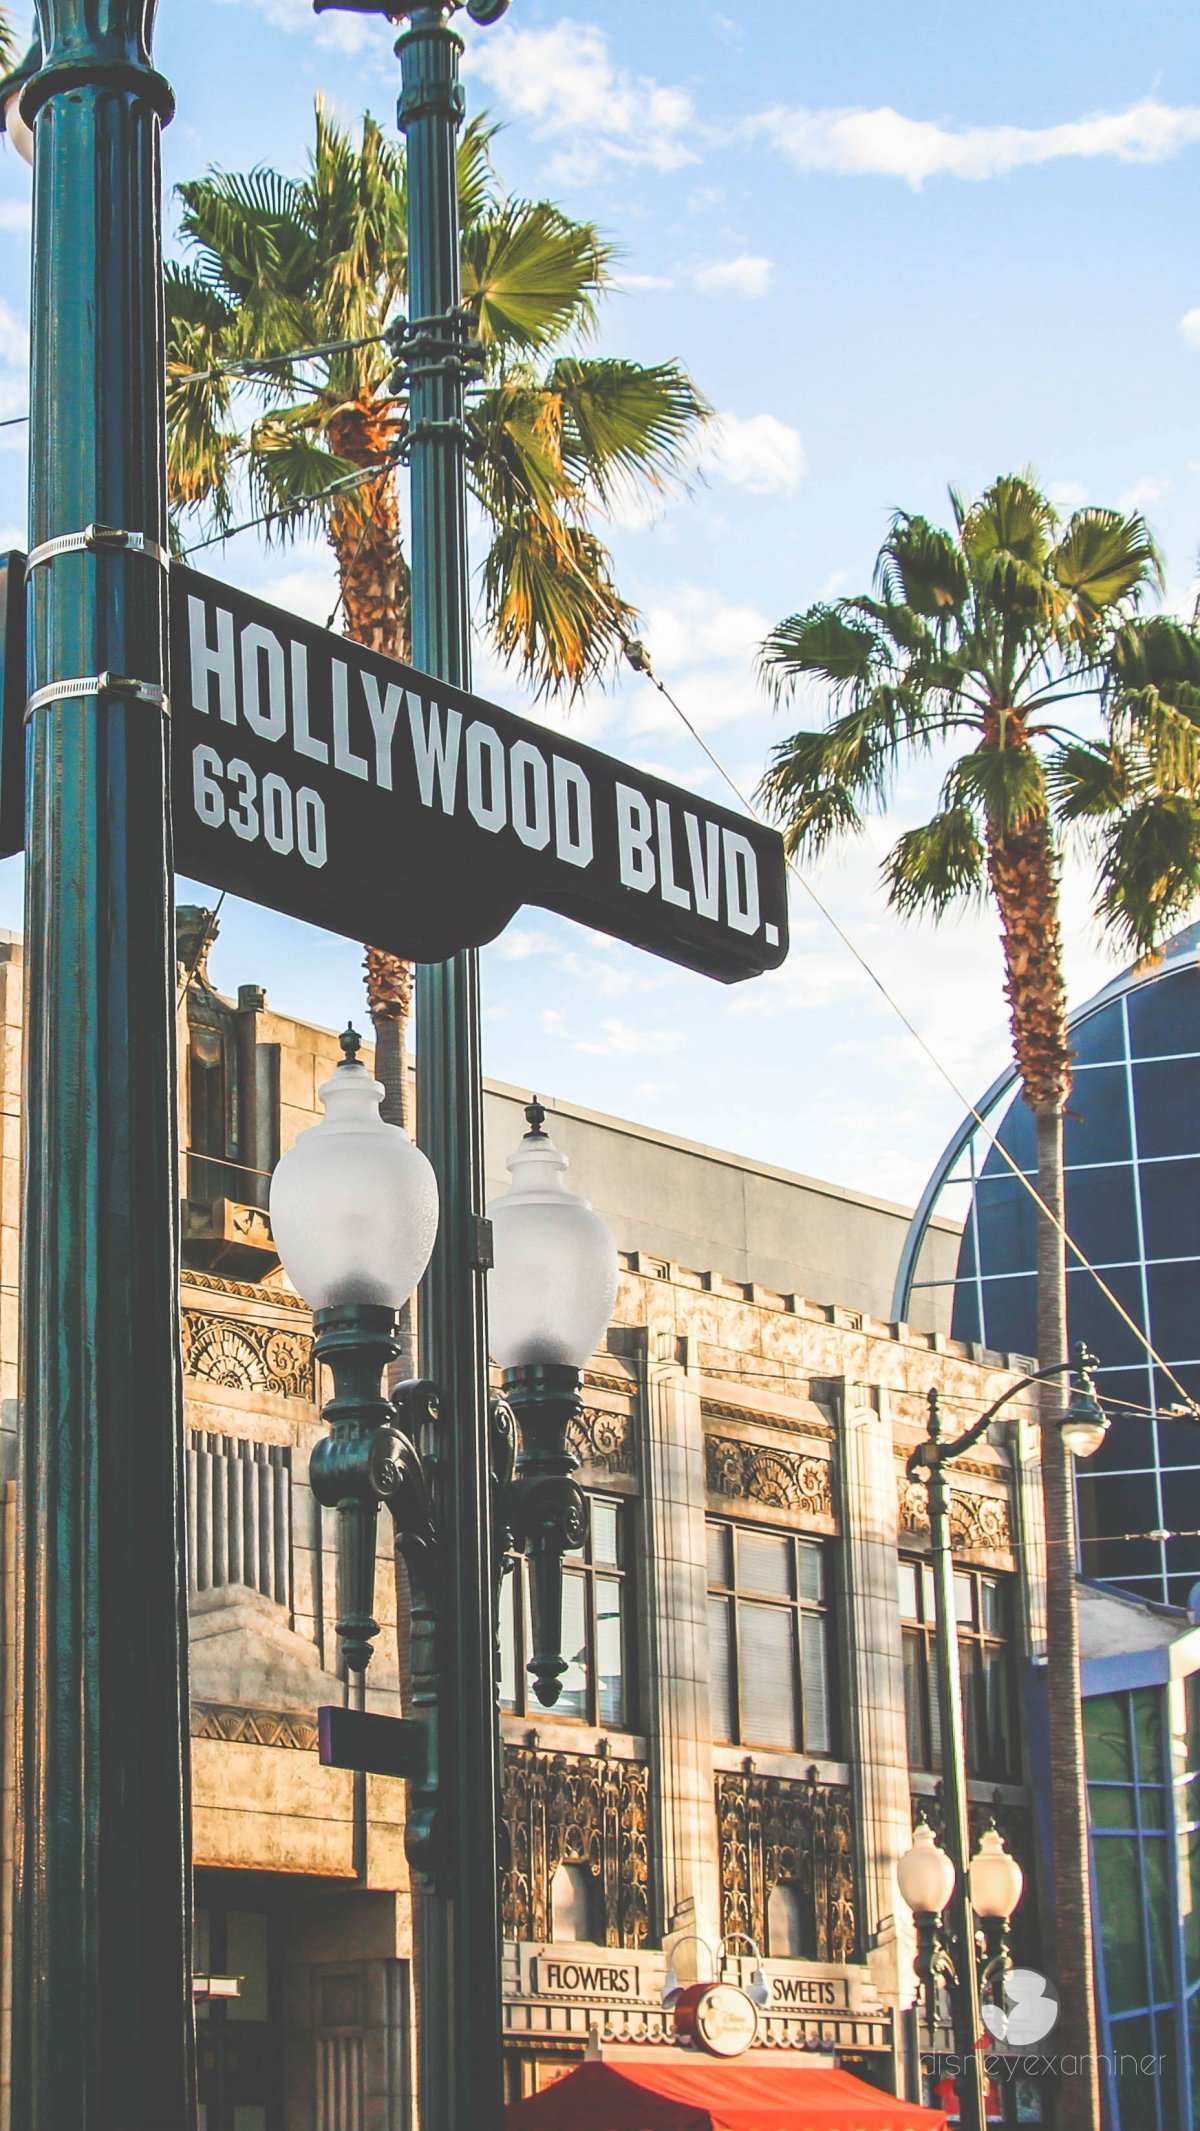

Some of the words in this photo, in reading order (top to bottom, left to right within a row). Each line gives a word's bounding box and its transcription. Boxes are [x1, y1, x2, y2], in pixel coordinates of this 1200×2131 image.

[188, 595, 594, 868] HOLLYWOOD
[615, 782, 780, 946] BLVD.
[192, 744, 328, 869] 6300
[547, 1965, 630, 1992] FLOWERS
[773, 1979, 835, 2005] SWEETS
